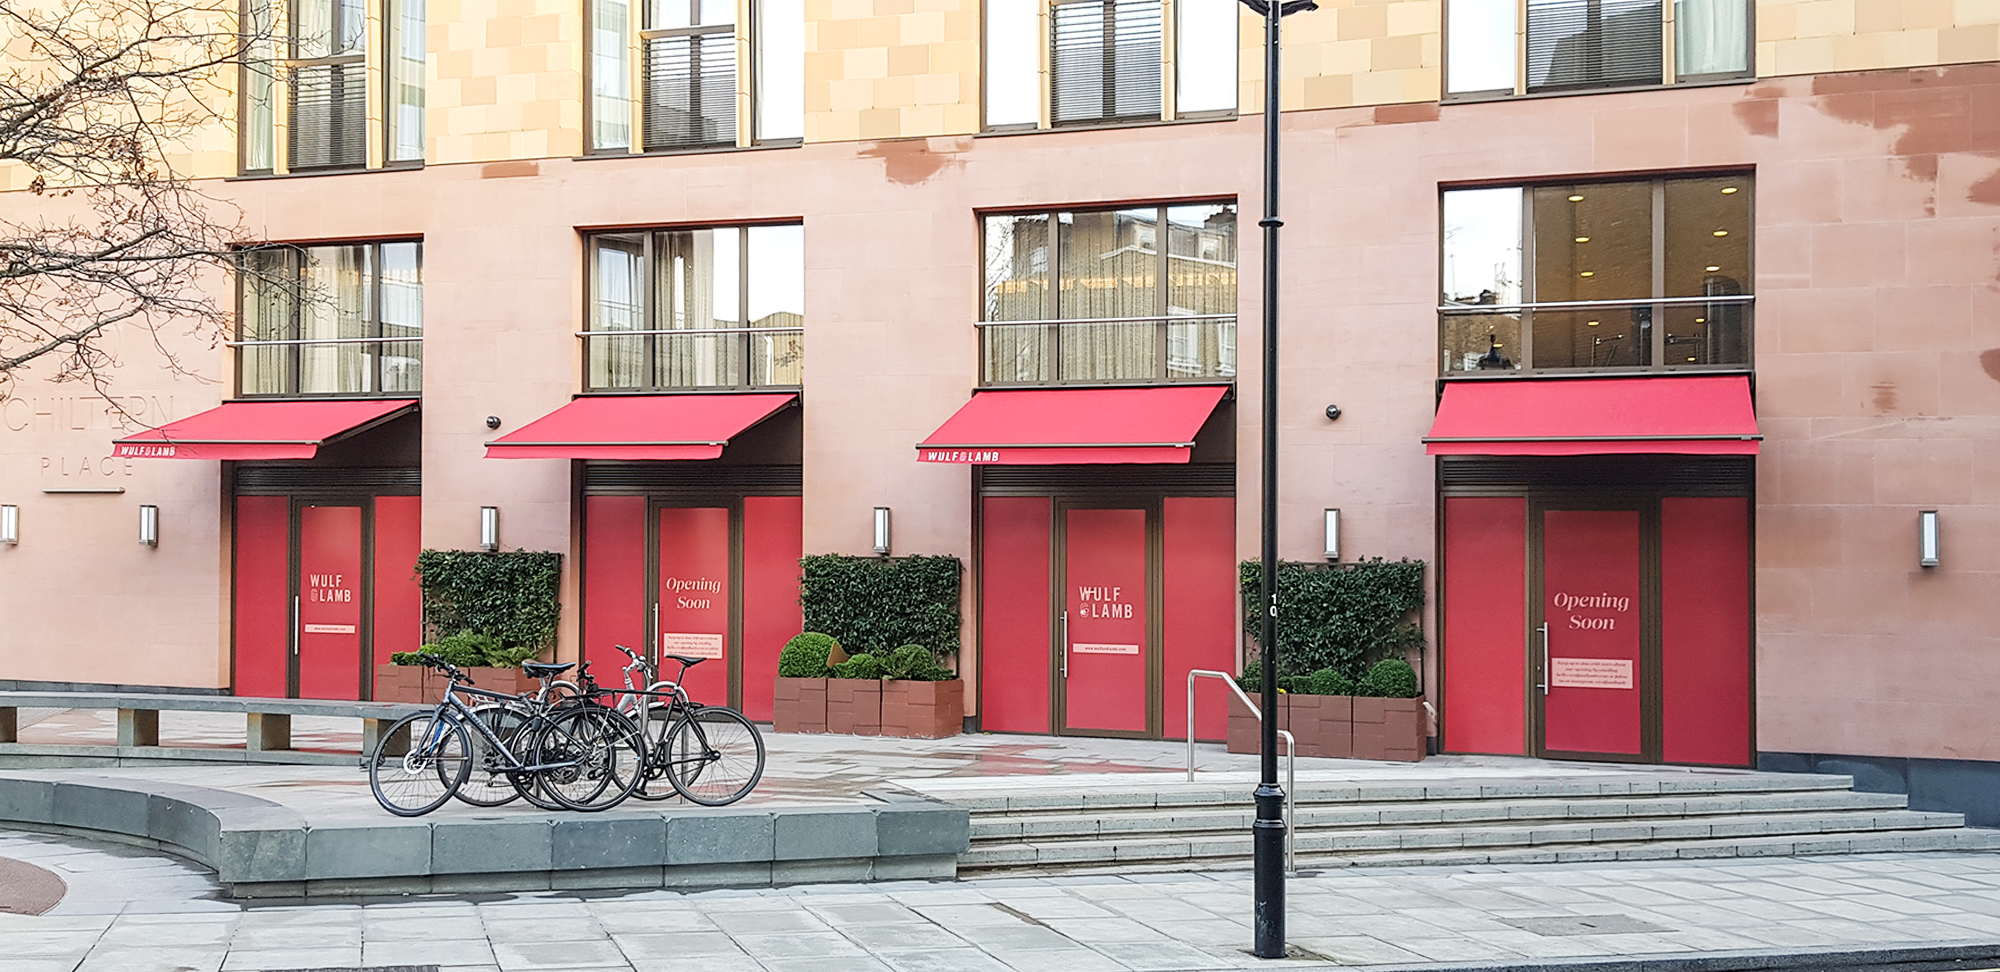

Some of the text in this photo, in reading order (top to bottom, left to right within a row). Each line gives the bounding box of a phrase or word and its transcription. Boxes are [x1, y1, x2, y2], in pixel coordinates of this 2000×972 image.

[3, 395, 174, 432] CHILTERN
[41, 456, 133, 476] PLACE
[310, 574, 342, 587] WULF
[666, 577, 721, 594] Opening
[1079, 586, 1121, 601] WULF
[676, 596, 711, 609] Soon
[1553, 592, 1630, 612] Opening
[1569, 614, 1615, 630] Soon
